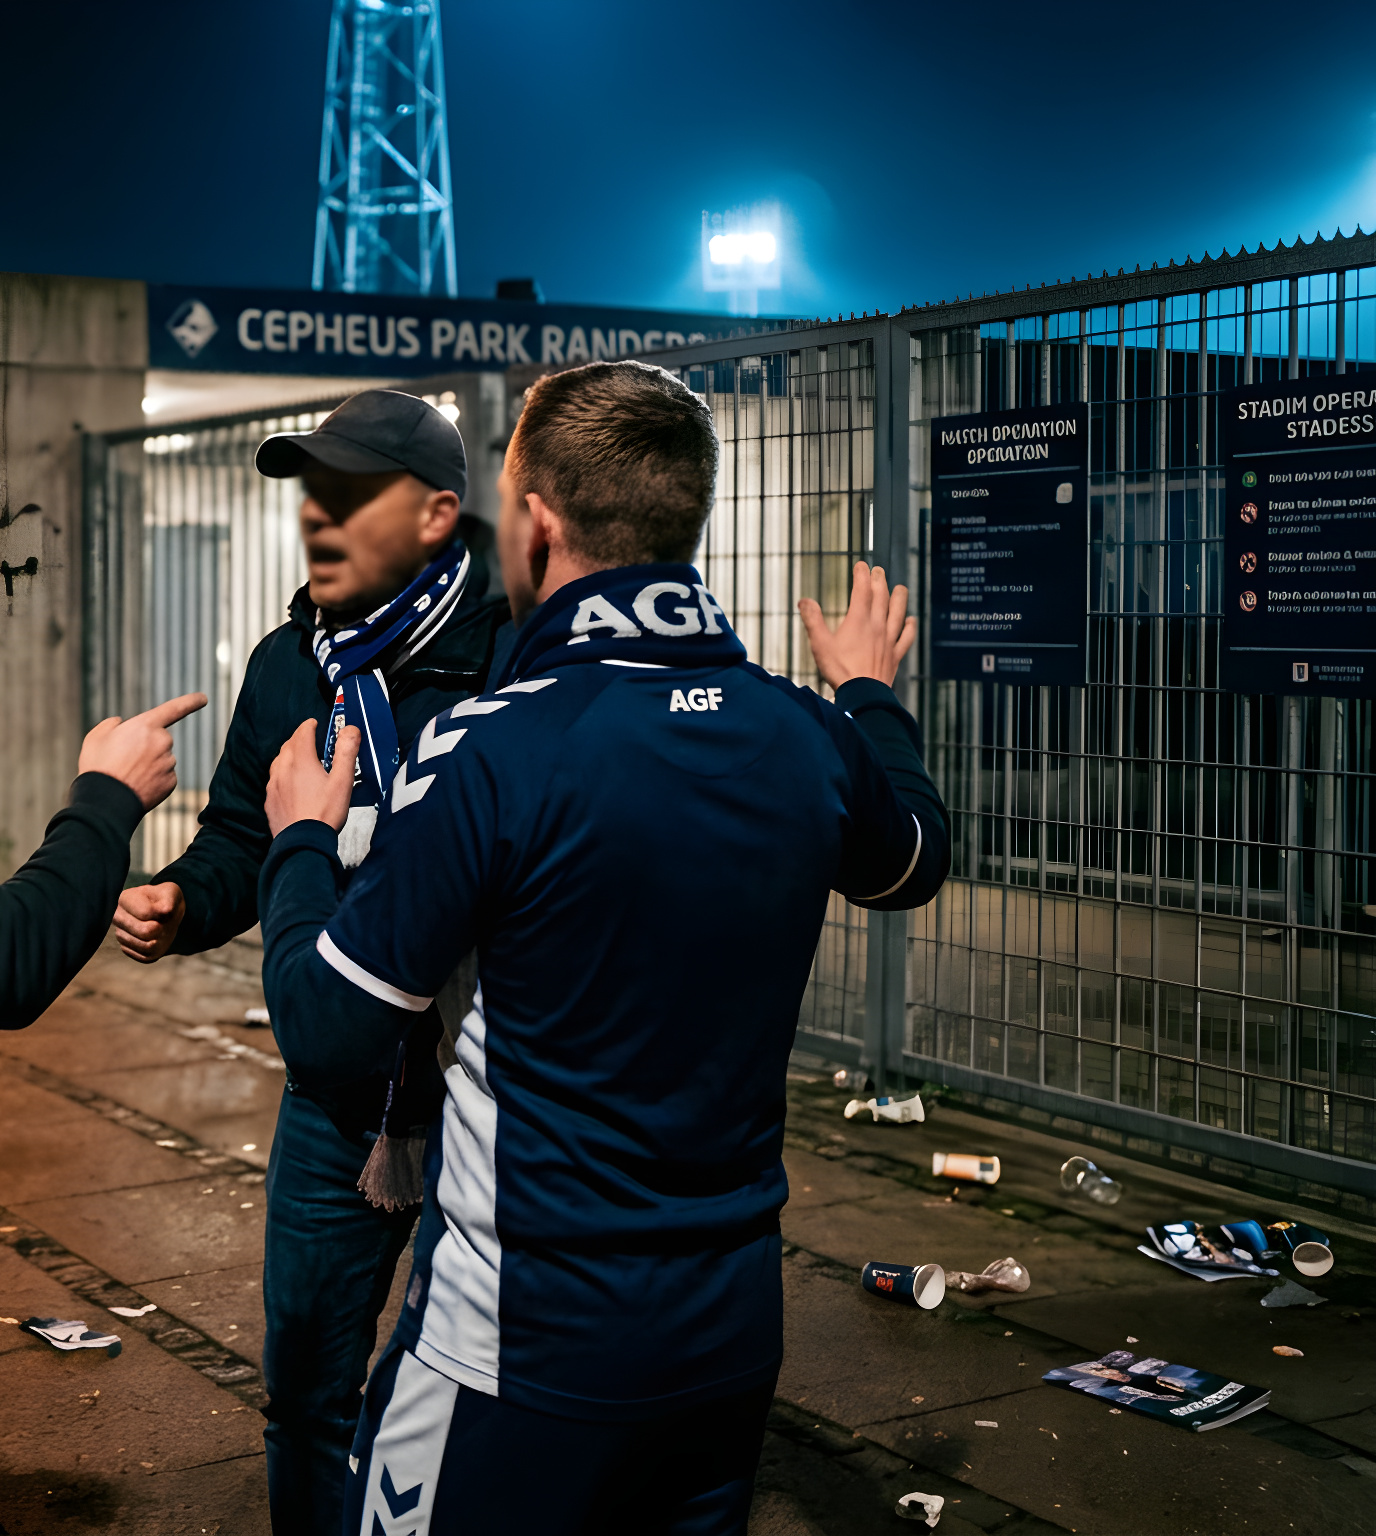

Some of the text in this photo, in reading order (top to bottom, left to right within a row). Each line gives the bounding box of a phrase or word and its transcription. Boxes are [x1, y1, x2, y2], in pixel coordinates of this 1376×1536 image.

[237, 307, 421, 357] CEPHEUS
[430, 317, 534, 365] PARK
[1238, 395, 1307, 420] STADIM
[1287, 414, 1375, 439] STADESS
[567, 581, 724, 646] AGF
[669, 687, 723, 712] AGF
